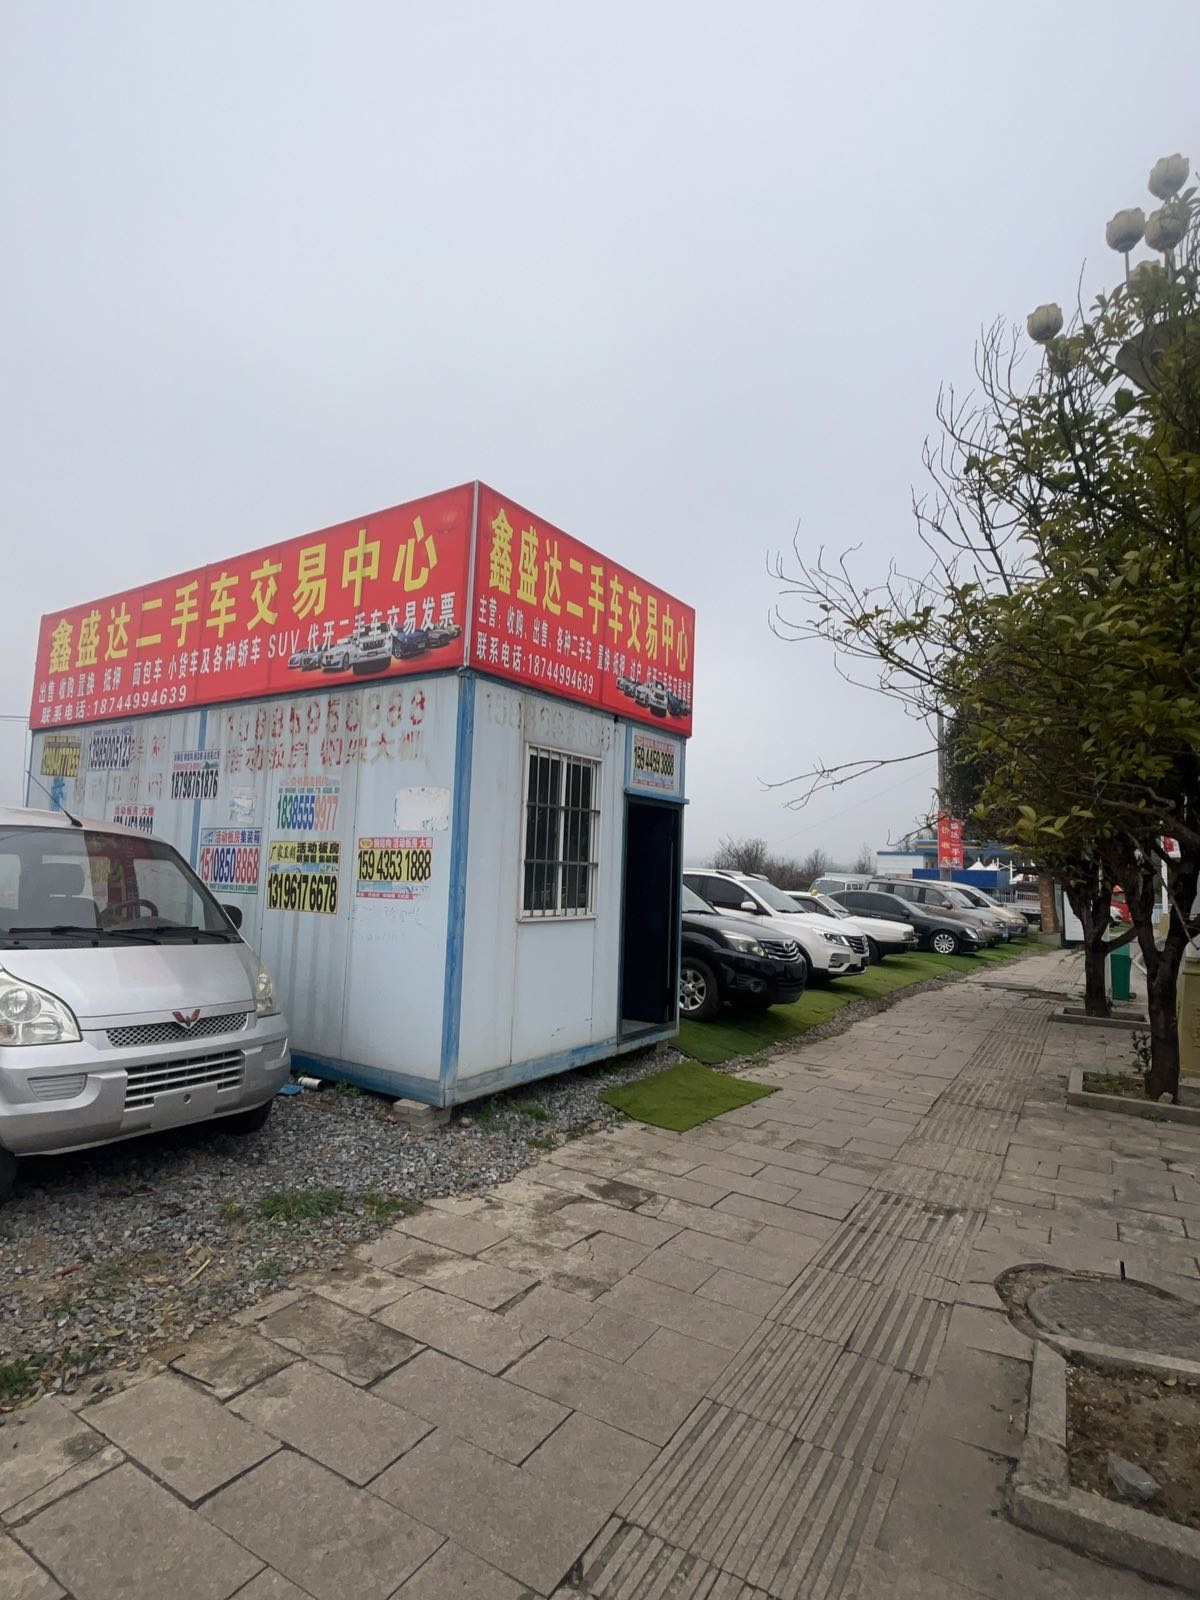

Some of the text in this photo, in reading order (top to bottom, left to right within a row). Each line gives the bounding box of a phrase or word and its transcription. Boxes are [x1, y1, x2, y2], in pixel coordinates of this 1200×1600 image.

[48, 515, 438, 676] 鑫盛达二手车交易中心
[488, 507, 688, 672] 鑫盛达二手车交易中心
[38, 591, 456, 703] 出售 收购 置换 抵押 面包车 小货车及各种轿车 SUV 代开二手车交易发票
[171, 770, 218, 799] 18798761876
[277, 794, 339, 831] 18385559977
[201, 847, 259, 884] 15108508868
[297, 842, 339, 854] 活动板房
[358, 850, 432, 881] 159 4353 1888
